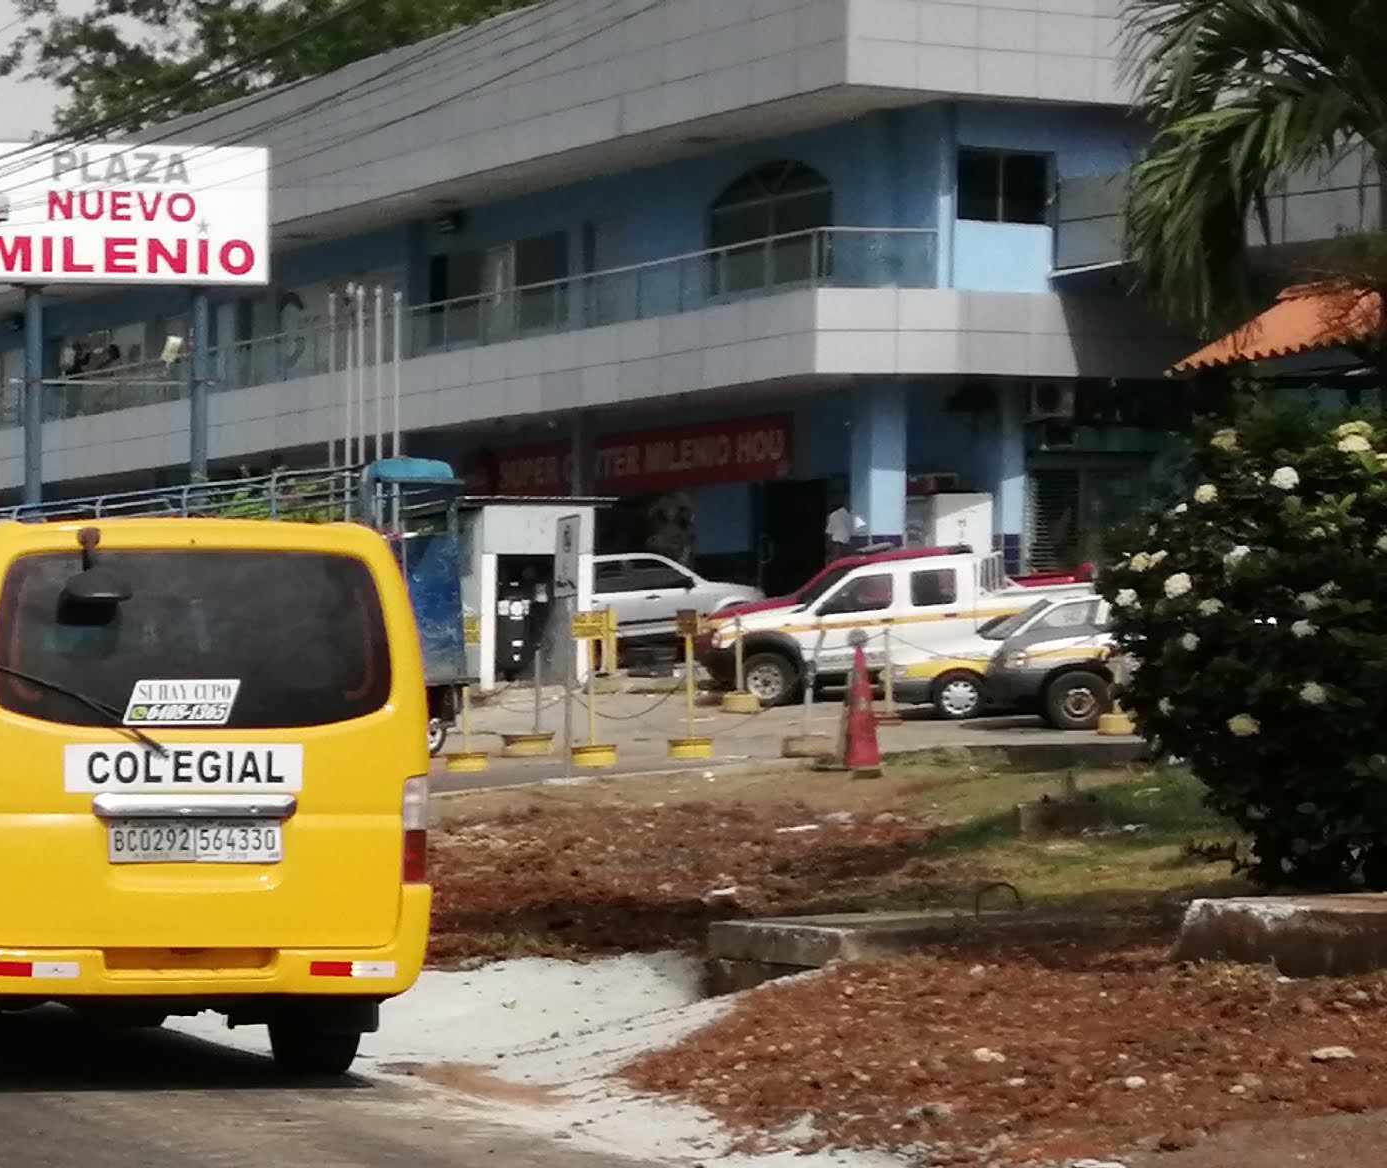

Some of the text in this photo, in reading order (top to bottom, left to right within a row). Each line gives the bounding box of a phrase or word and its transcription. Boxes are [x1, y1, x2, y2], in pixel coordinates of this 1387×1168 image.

[52, 152, 190, 184] PLAZA
[48, 190, 196, 222] NUEVO
[645, 434, 730, 472] MILENIO
[736, 429, 785, 463] HOU
[138, 684, 232, 700] SI HAY CUPO
[87, 750, 285, 784] COLEGIAL
[113, 829, 277, 851] BC0292 564330
